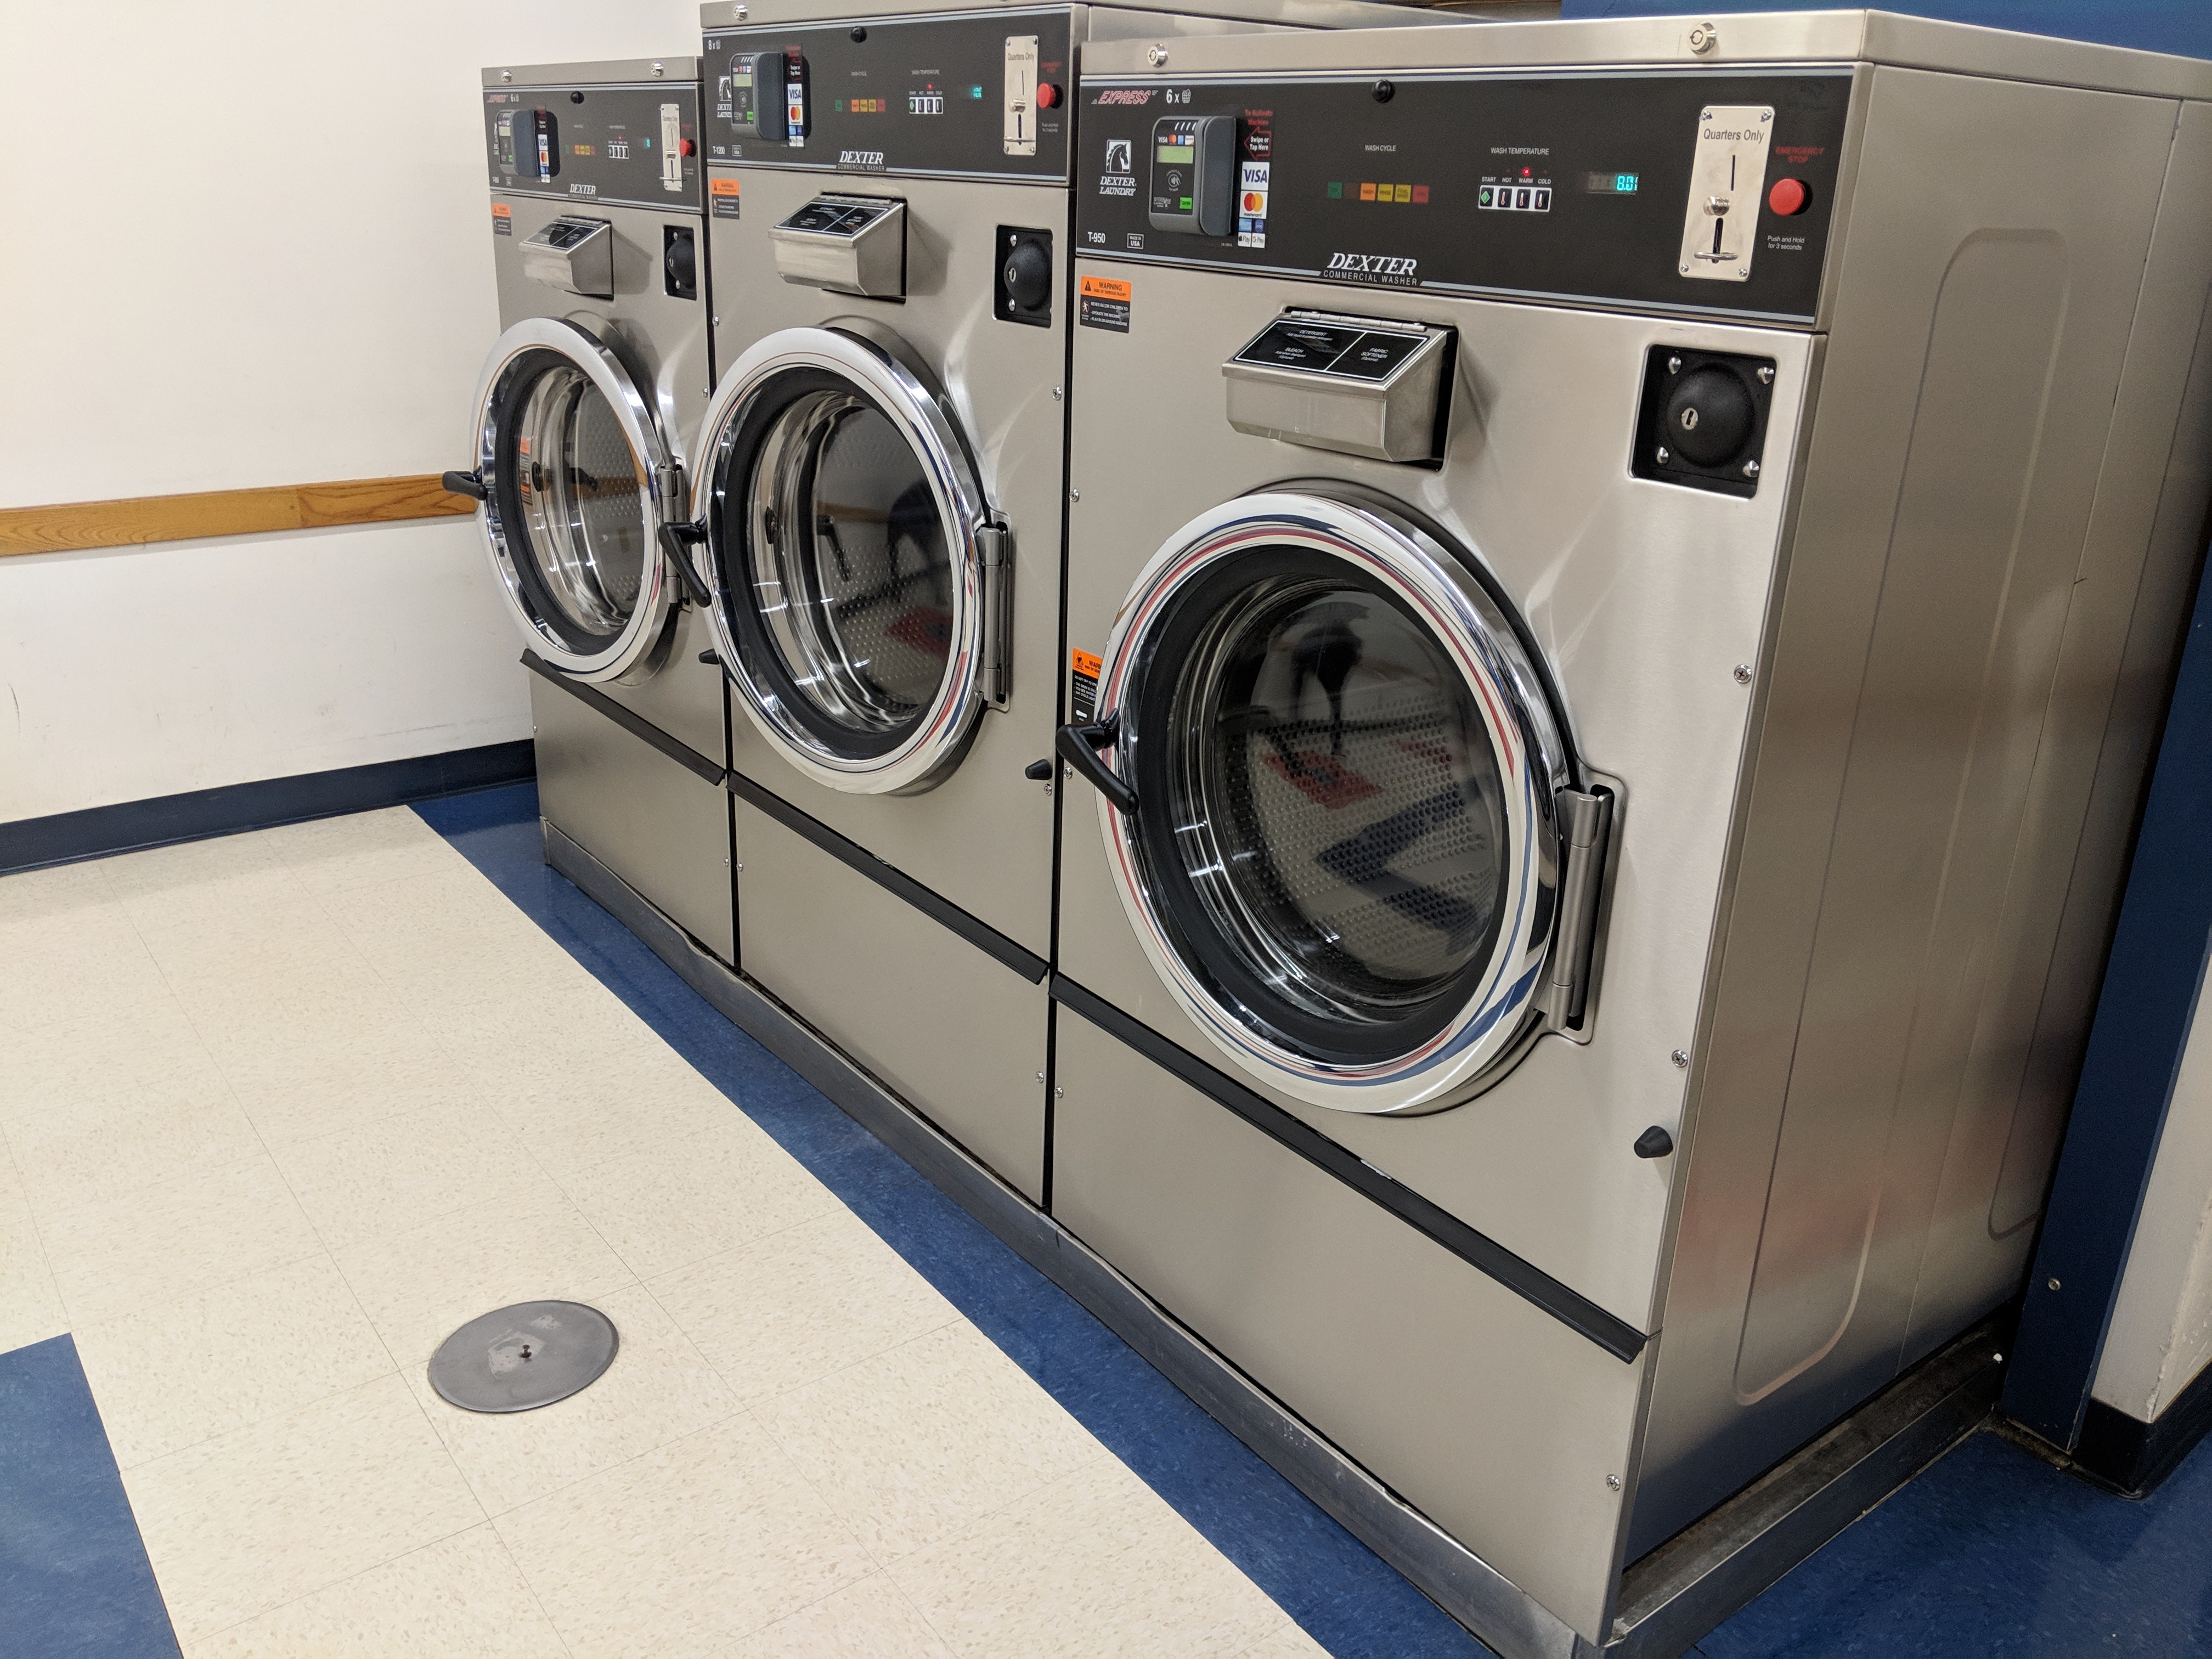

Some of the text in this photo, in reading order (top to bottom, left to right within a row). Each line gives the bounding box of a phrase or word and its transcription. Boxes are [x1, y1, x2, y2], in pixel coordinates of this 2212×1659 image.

[708, 40, 712, 50] 8
[789, 89, 802, 99] VISA
[1098, 89, 1180, 104] EXPRESS 6 x
[1703, 128, 1764, 144] Quarters Only
[839, 151, 883, 165] DEXTER
[1100, 176, 1135, 186] DEXTER
[1243, 169, 1267, 183] VISA
[569, 183, 596, 195] DEXTER
[1099, 187, 1136, 196] LAUNDRY
[1087, 232, 1105, 243] T-950
[1327, 252, 1417, 276] DEXTER
[1323, 270, 1417, 286] COMMERCIAL WASHER
[1099, 282, 1122, 291] WARNING
